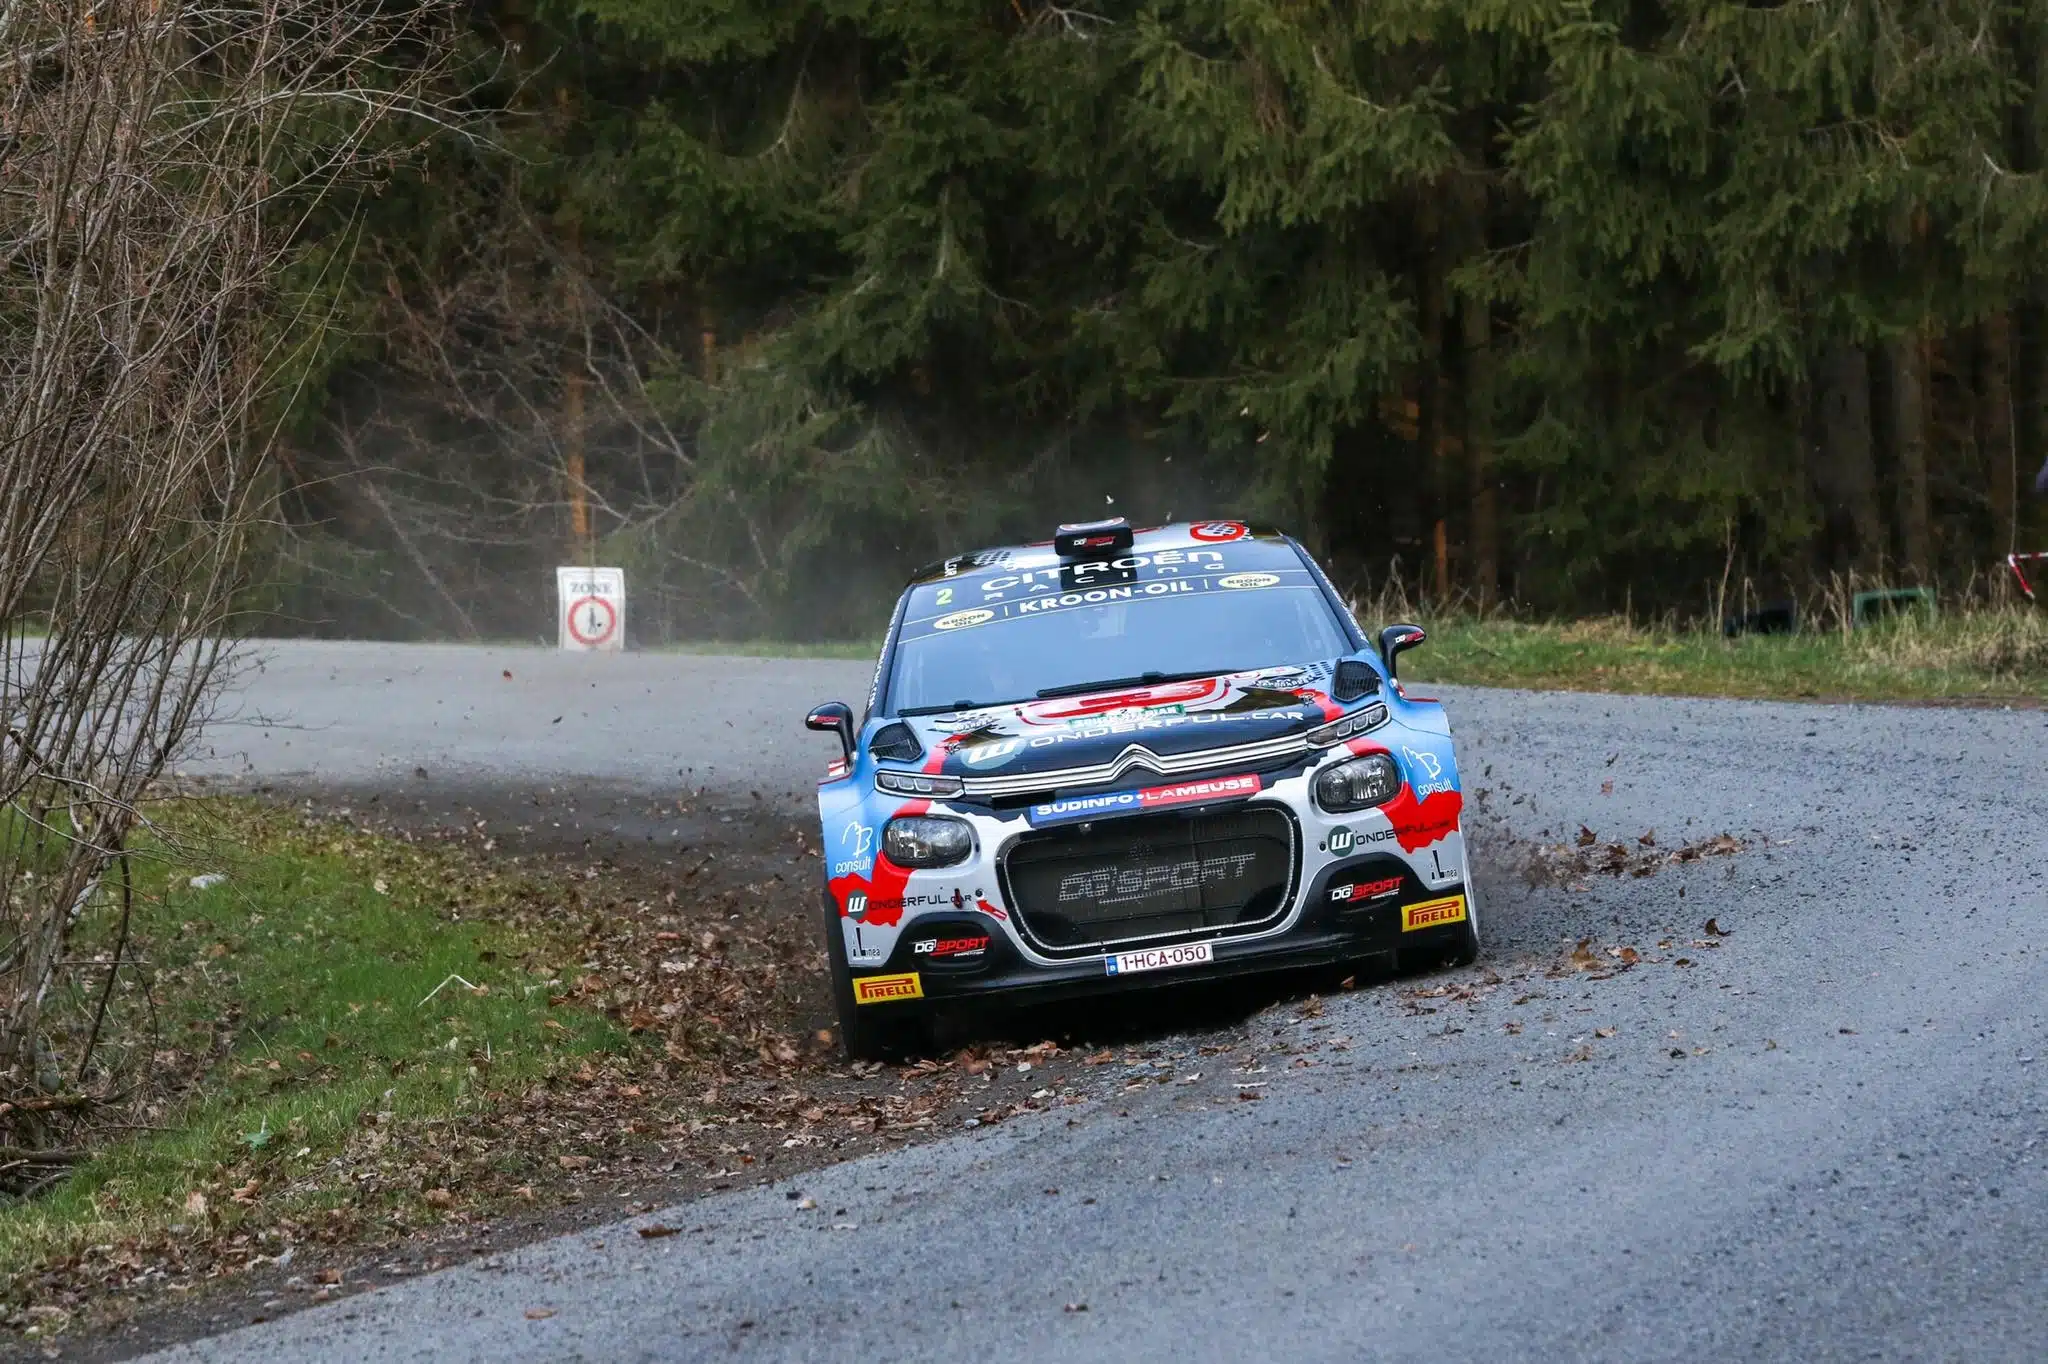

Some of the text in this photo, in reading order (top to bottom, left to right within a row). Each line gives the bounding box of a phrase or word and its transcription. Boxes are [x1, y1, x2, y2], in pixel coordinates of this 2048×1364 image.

[982, 551, 1224, 592] CITROËN
[569, 583, 613, 593] ZONE
[936, 588, 952, 606] 2
[1019, 579, 1194, 613] KROON-OIL
[1037, 777, 1255, 816] SUDINFO LAMEUSE
[1417, 778, 1455, 797] consult
[835, 857, 872, 874] consult
[1408, 900, 1460, 926] PIRELLI
[1121, 946, 1207, 970] 1-HCA-050
[860, 978, 916, 1000] PIRELLI
